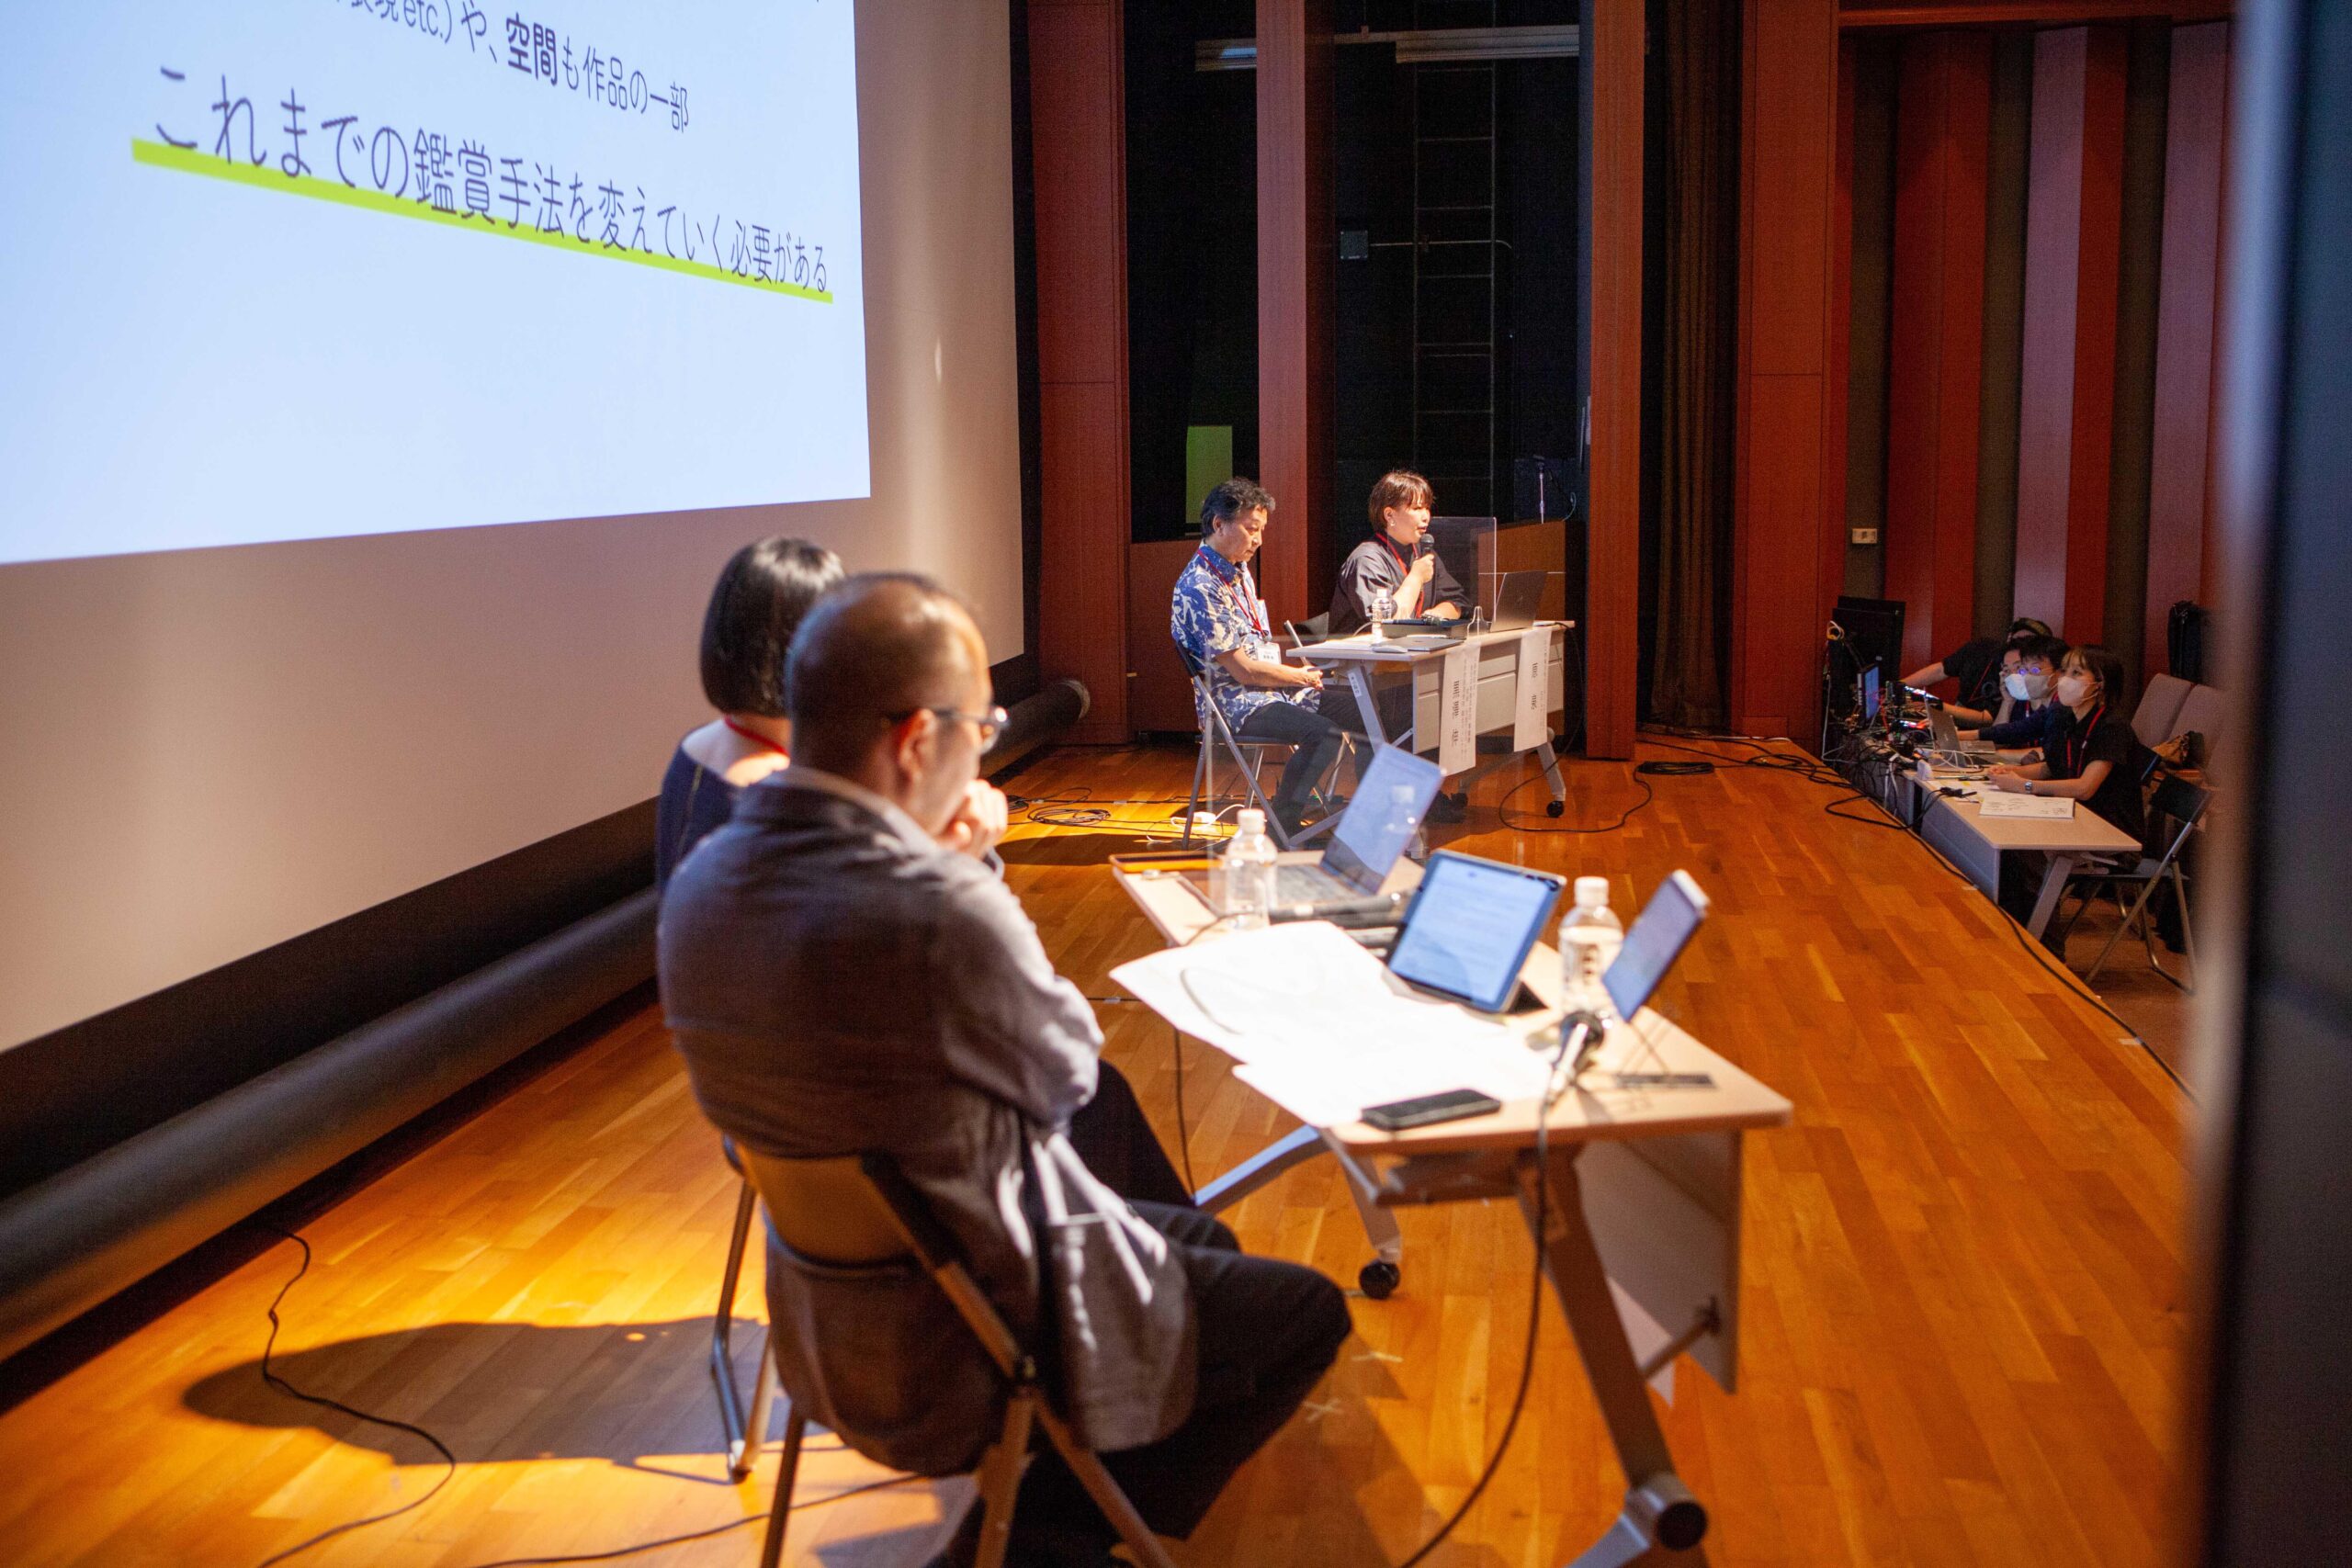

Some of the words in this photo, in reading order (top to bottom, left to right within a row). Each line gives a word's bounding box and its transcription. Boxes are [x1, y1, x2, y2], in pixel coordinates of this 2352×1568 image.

[352, 0, 689, 134] etc.)や、空間も作品の一部
[155, 66, 827, 292] これまでの鑑賞手法を変えていく必要がある
